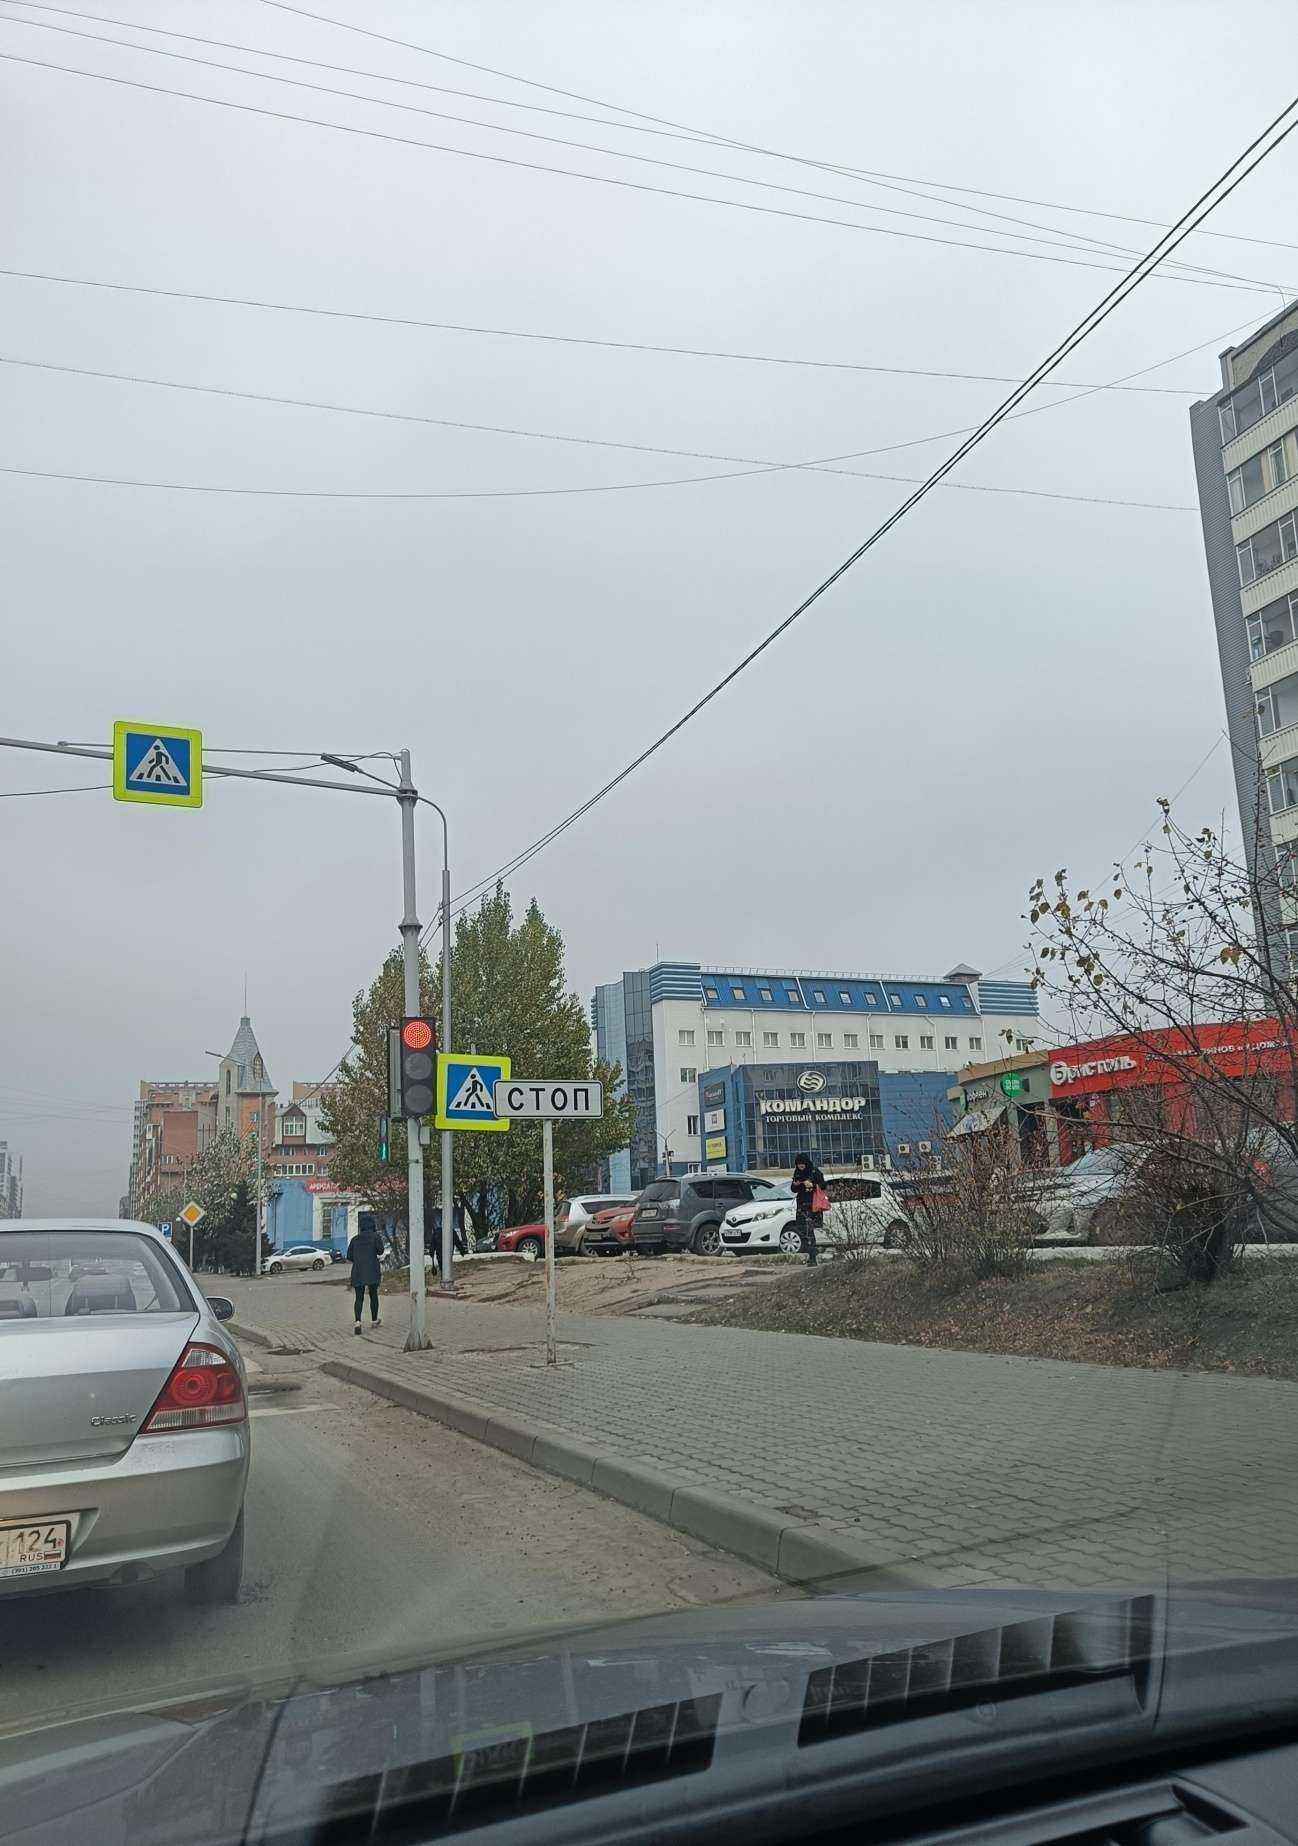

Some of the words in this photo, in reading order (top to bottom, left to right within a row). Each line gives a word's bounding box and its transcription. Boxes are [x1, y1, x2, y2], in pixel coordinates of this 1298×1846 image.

[508, 1087, 589, 1111] СТОП
[760, 1096, 866, 1114] КОМАНДОР
[815, 1111, 865, 1121] КОМПЛЕКС
[15, 1527, 57, 1553] 124
[19, 1552, 45, 1562] RUS
